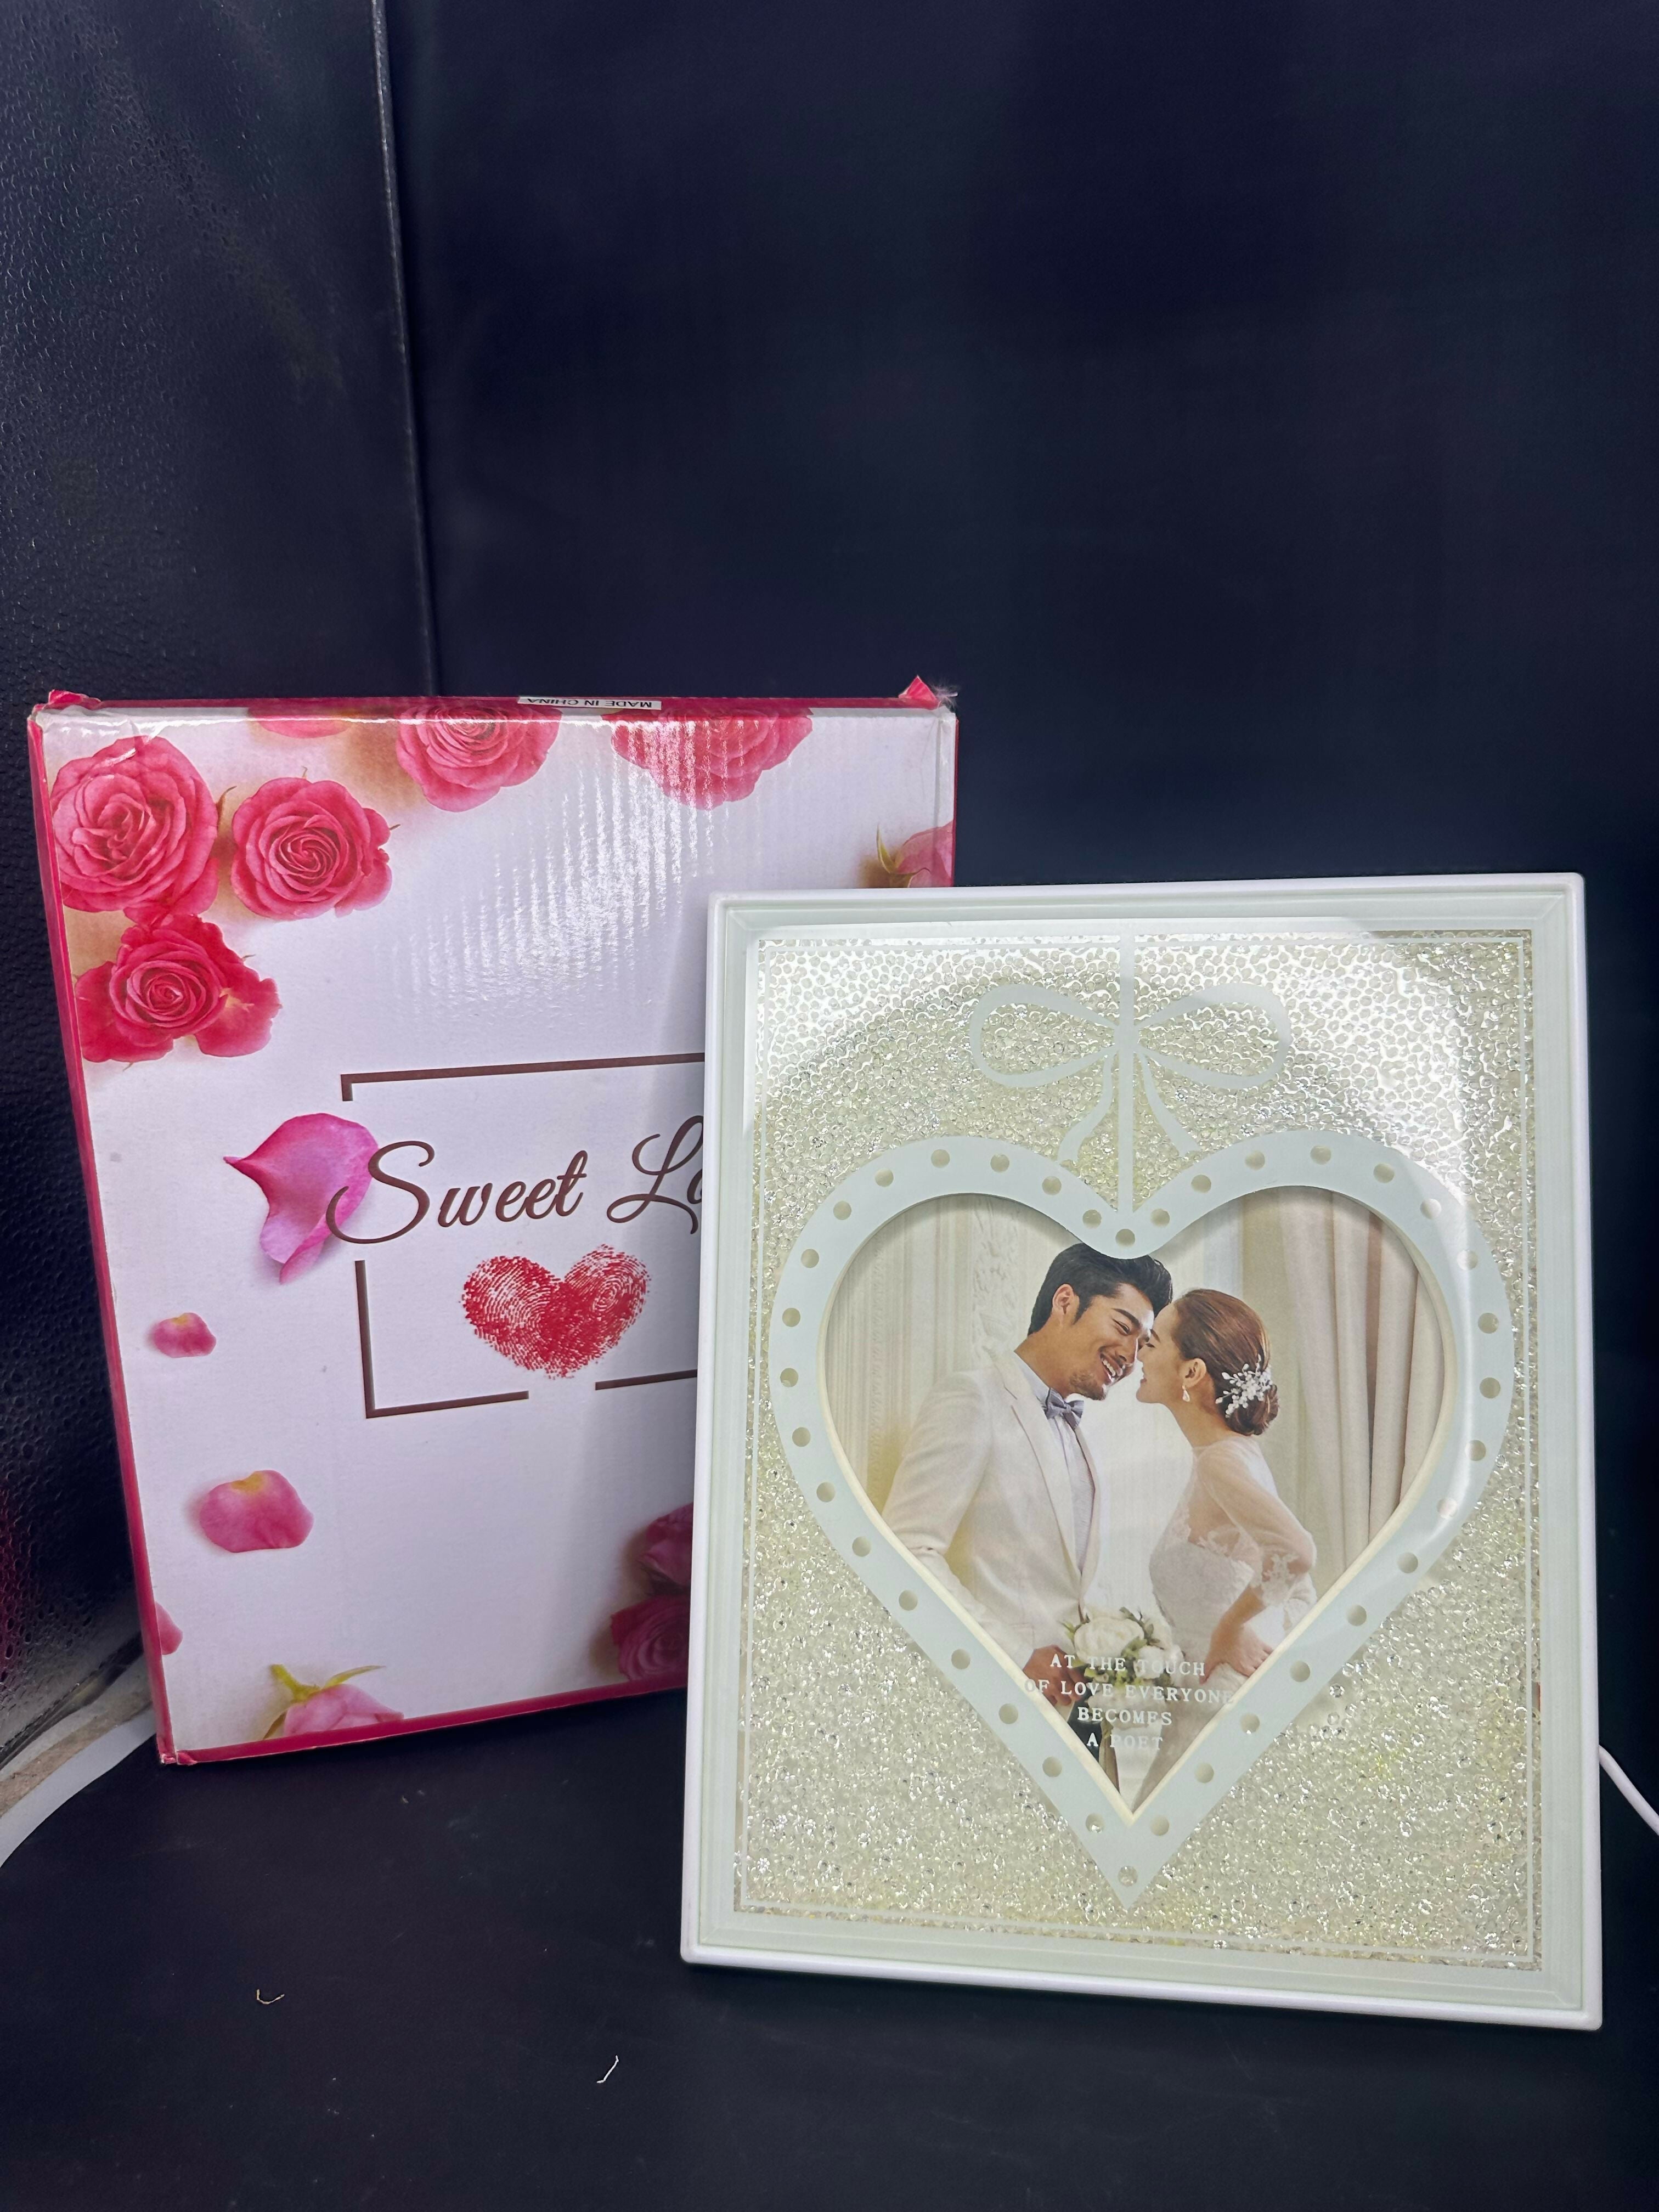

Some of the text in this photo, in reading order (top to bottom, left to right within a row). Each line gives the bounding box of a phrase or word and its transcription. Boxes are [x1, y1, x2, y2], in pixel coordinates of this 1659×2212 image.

[326, 1141, 588, 1244] Sweet
[1050, 1654, 1205, 1676] AT THE TOUCH
[1025, 1679, 1232, 1704] OF LOVE EVERYONE
[1077, 1707, 1172, 1725] BECOMES
[1087, 1733, 1163, 1751] A POET
